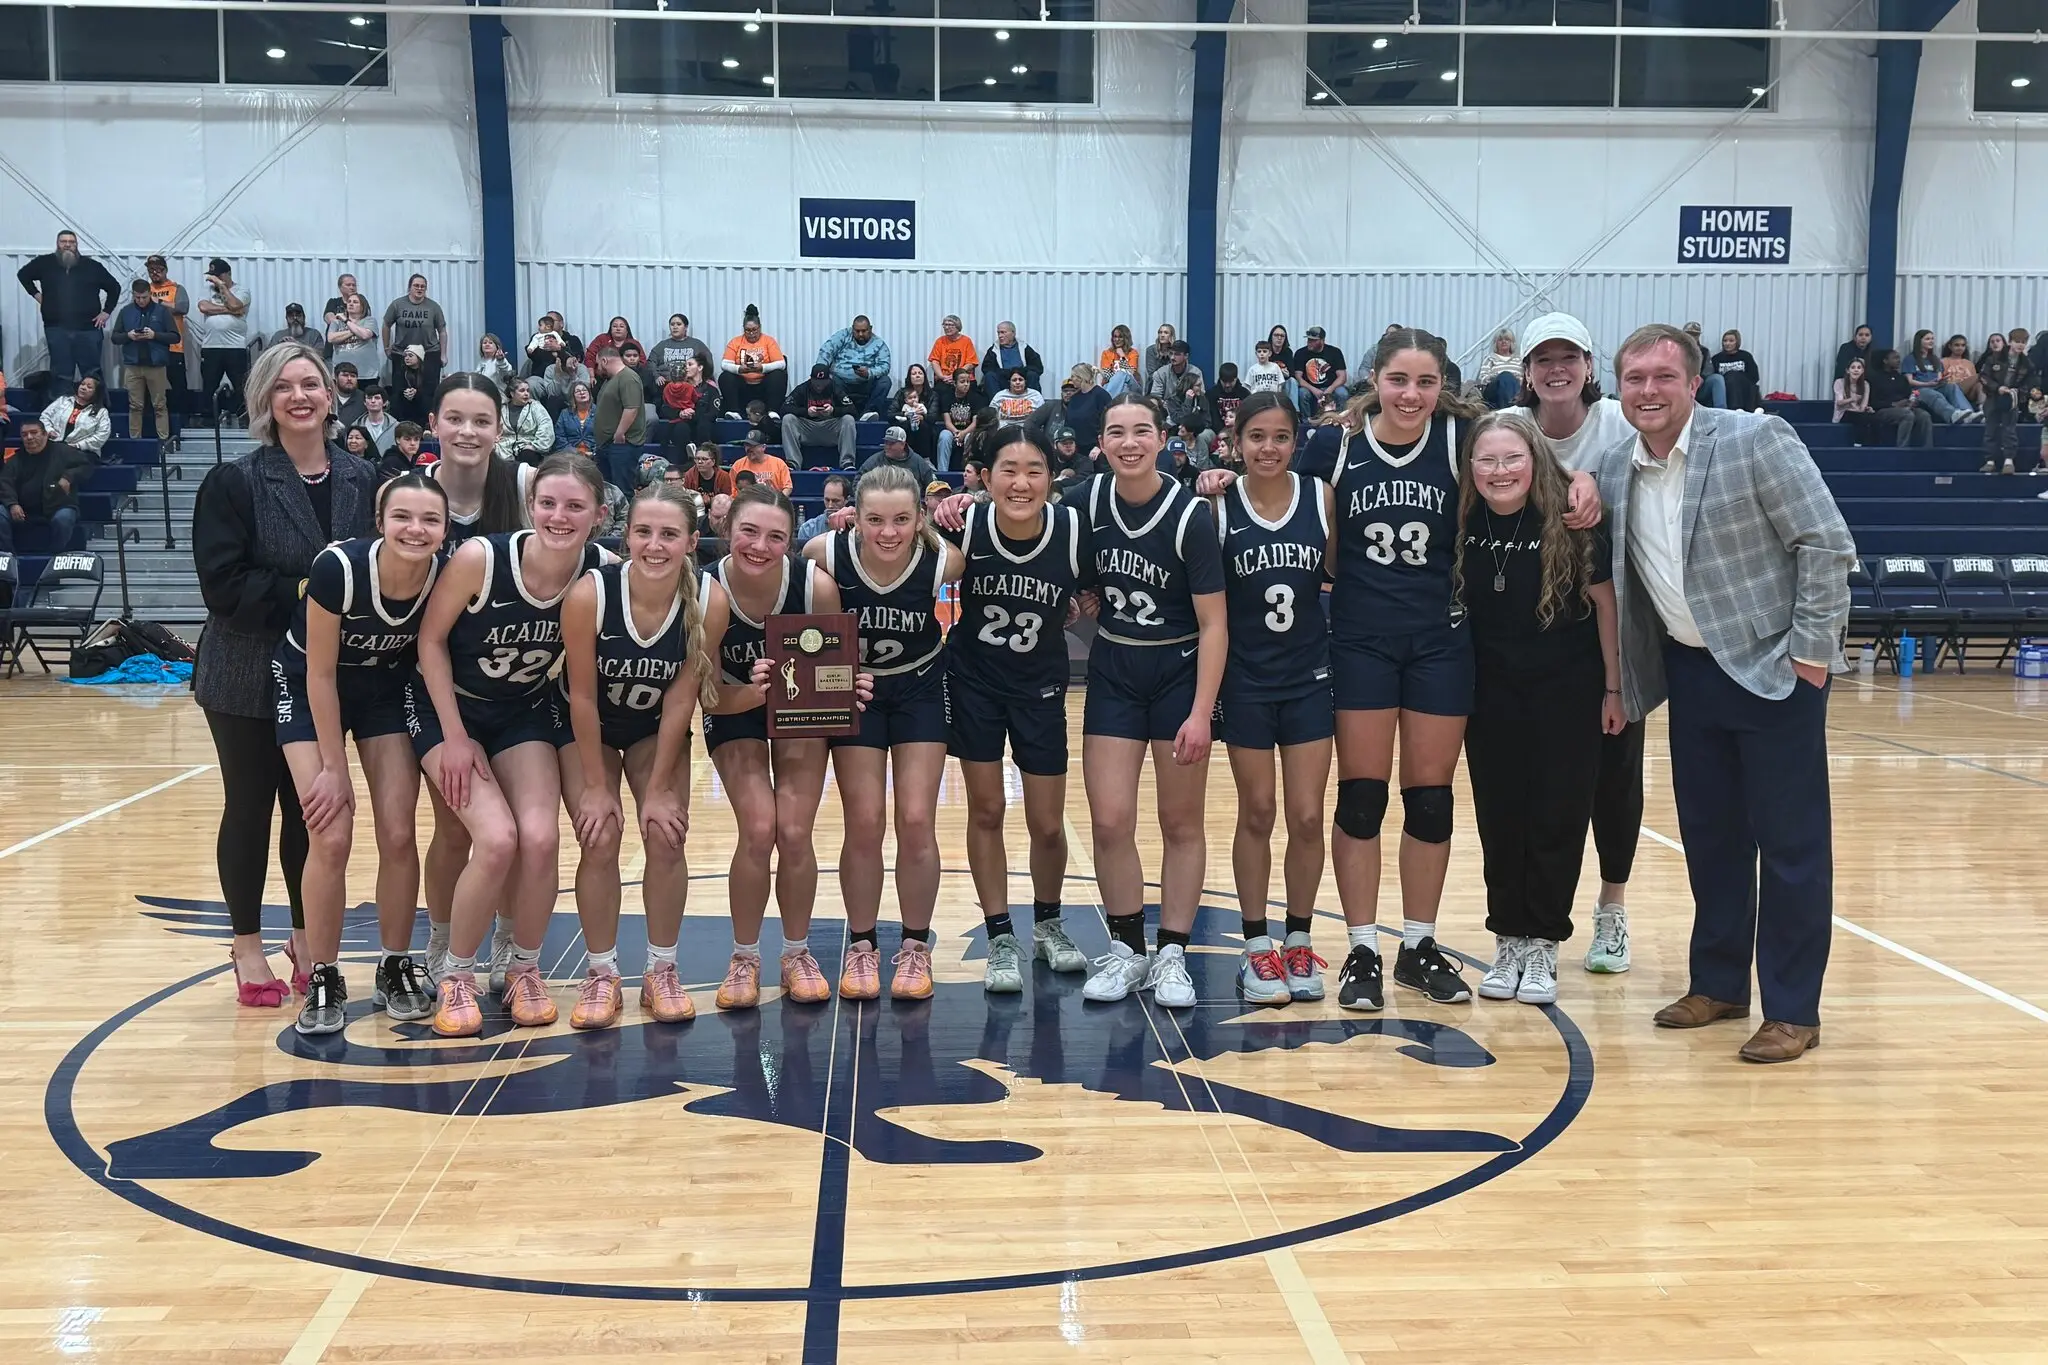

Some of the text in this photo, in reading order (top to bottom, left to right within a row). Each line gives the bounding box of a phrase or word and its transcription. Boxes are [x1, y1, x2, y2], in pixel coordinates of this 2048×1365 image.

[804, 216, 912, 241] VISITORS
[1701, 209, 1770, 232] HOME
[1682, 236, 1786, 258] STUDENTS
[402, 309, 429, 319] GAME
[404, 320, 424, 329] DAY
[1348, 480, 1447, 519] ACADEMY
[1364, 521, 1431, 566] 33
[53, 555, 96, 571] GRIFFINS
[1095, 547, 1172, 590] ACADEMY
[1234, 542, 1323, 578] ACADEMY
[1884, 559, 1926, 573] GRIFFINS
[1952, 558, 1994, 572] GRIFFINS
[971, 574, 1063, 608] ACADEMY
[841, 606, 927, 633] ADEMY
[1264, 583, 1296, 633] 3
[482, 619, 563, 645] ACADE
[783, 636, 840, 645] 20 25
[977, 604, 1043, 653] 23
[477, 647, 553, 683] 32
[606, 682, 662, 710] 10
